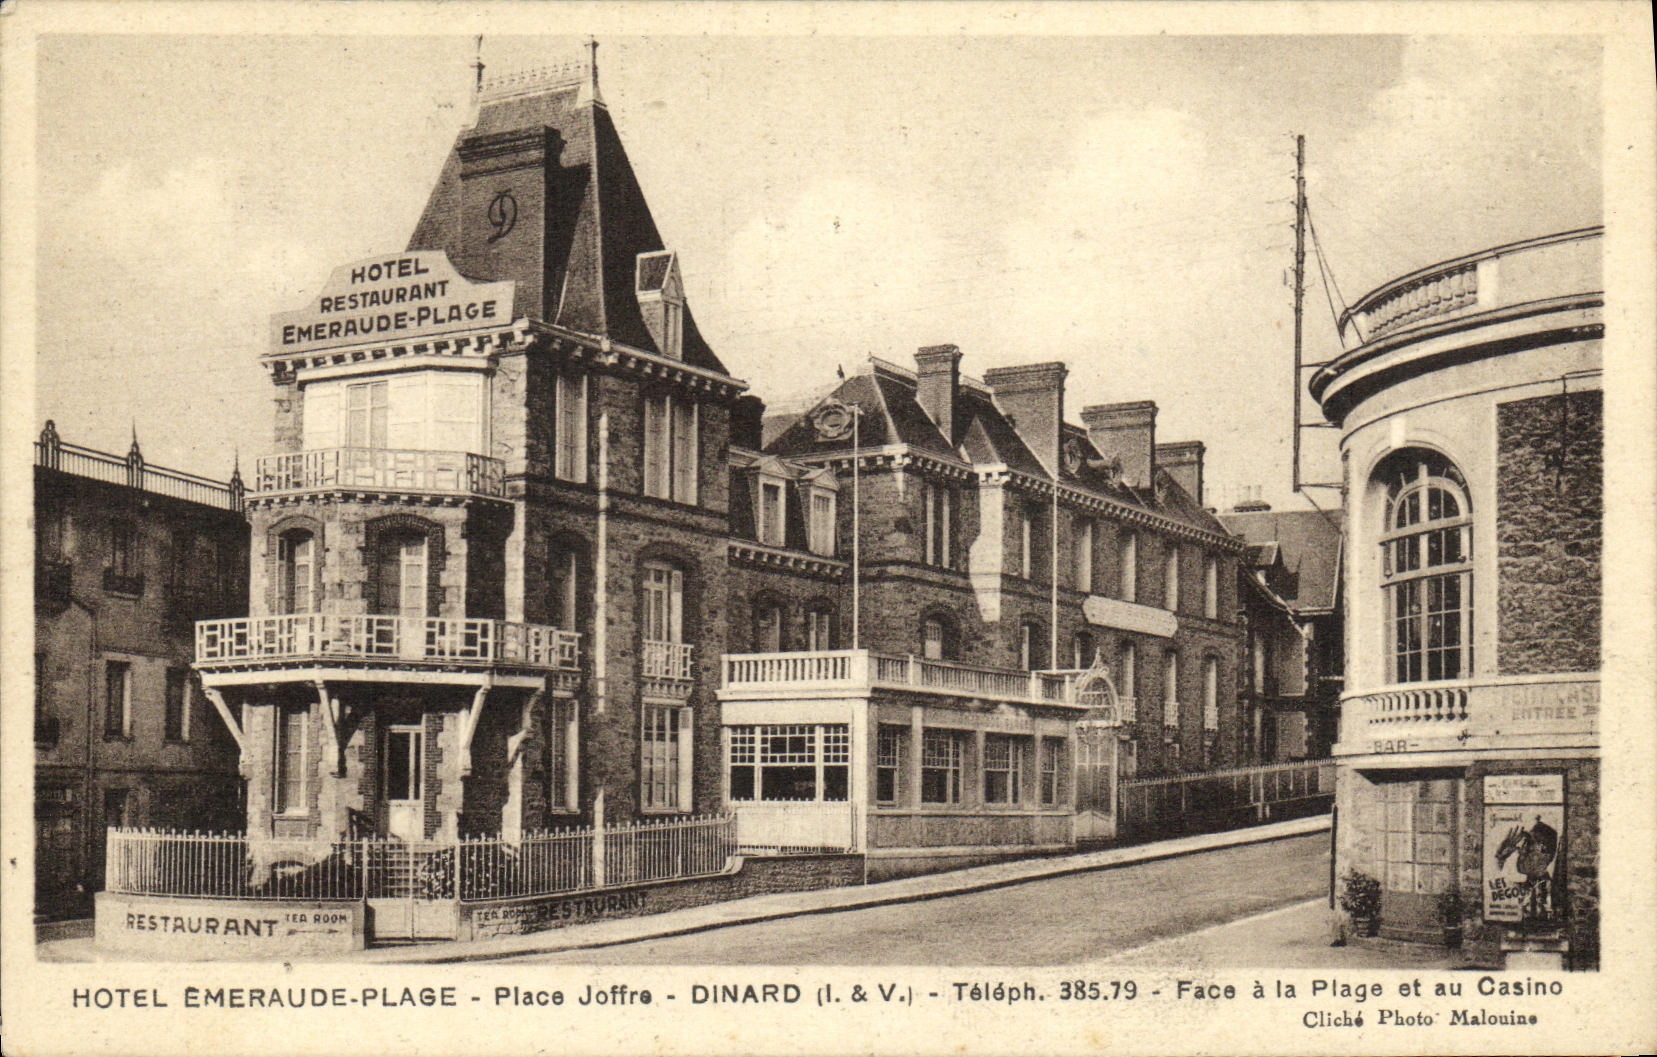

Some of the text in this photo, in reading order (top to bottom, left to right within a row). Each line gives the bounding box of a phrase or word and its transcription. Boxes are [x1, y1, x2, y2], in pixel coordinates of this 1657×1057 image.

[351, 258, 429, 284] HOTEL
[320, 280, 449, 313] RESTAURANT
[282, 300, 497, 345] EMERAUDE-PLAGE
[285, 914, 347, 924] TEA ROOM
[477, 909, 499, 921] TEA
[537, 891, 648, 921] RESTAURANT
[126, 912, 279, 937] RESTAURANT
